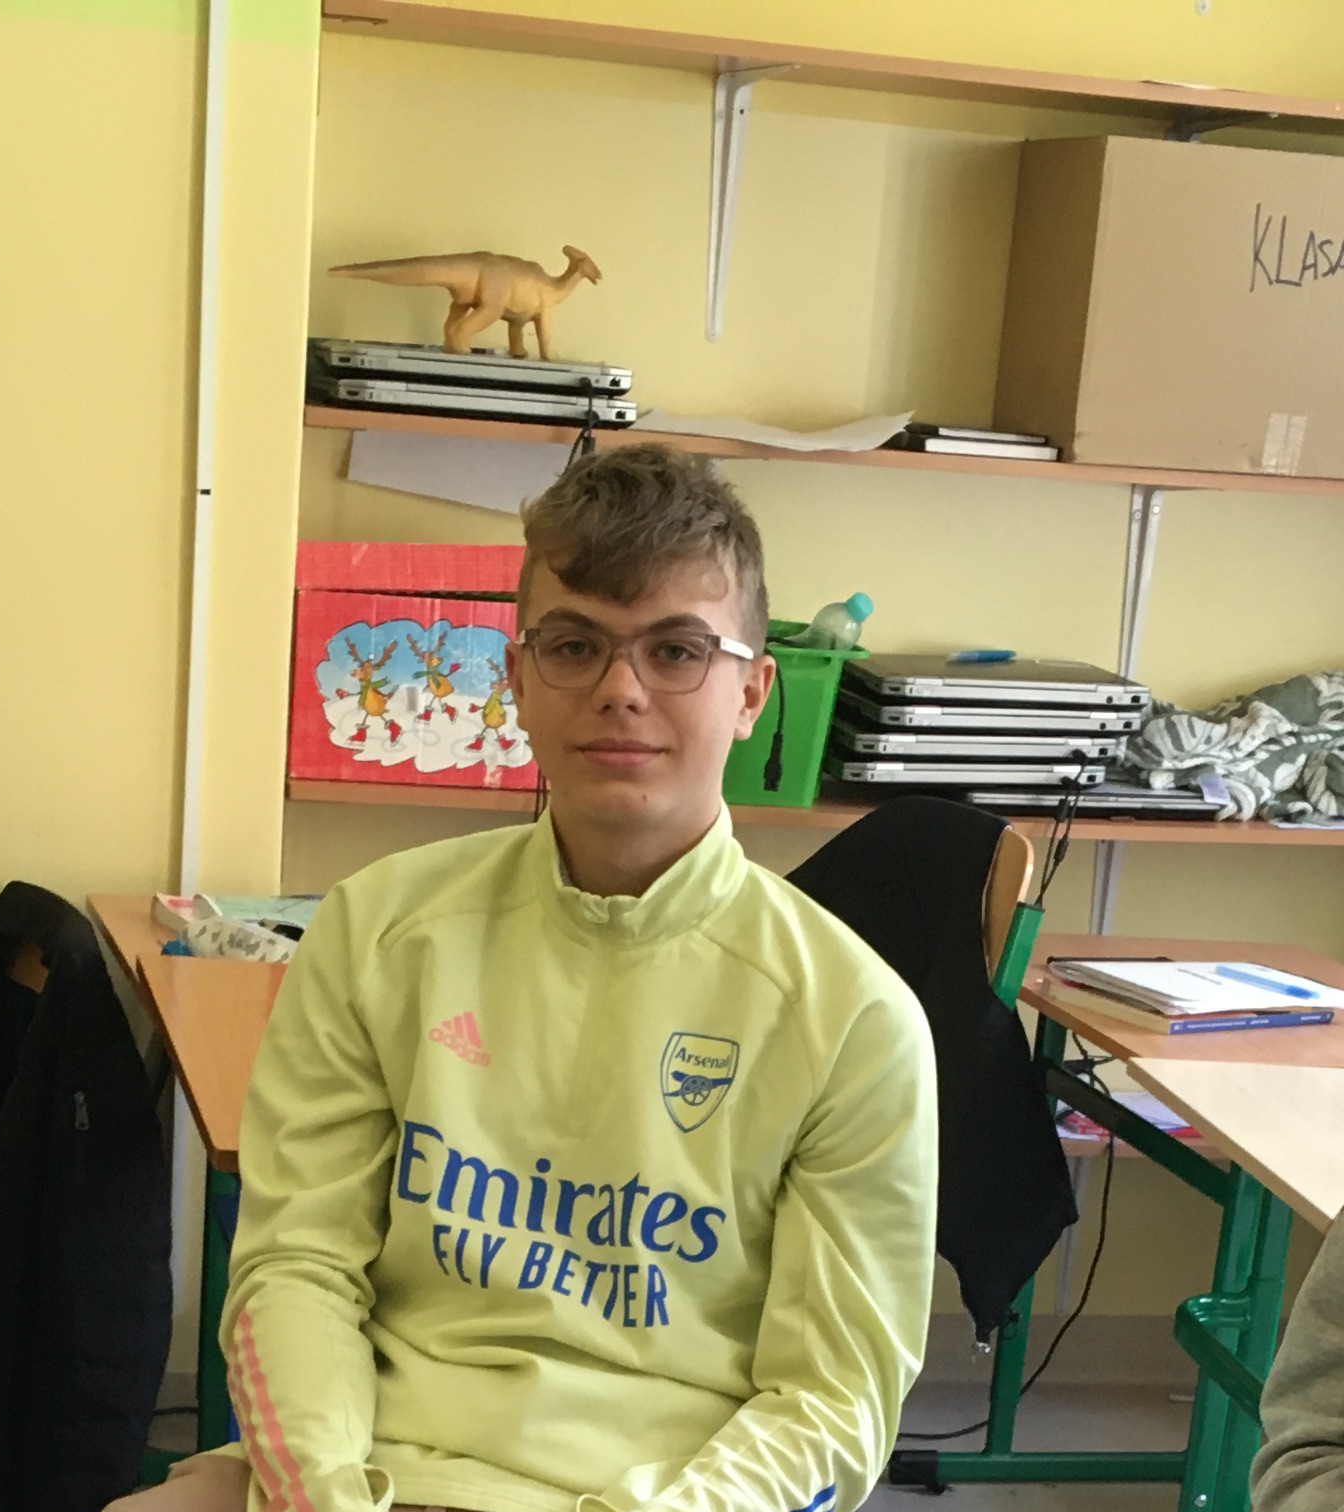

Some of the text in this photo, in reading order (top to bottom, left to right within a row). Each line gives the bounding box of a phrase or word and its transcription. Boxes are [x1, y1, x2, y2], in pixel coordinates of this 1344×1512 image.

[674, 1047, 731, 1069] Arsenal
[397, 1120, 727, 1263] Emirates
[433, 1224, 670, 1328] FLY BETTER
